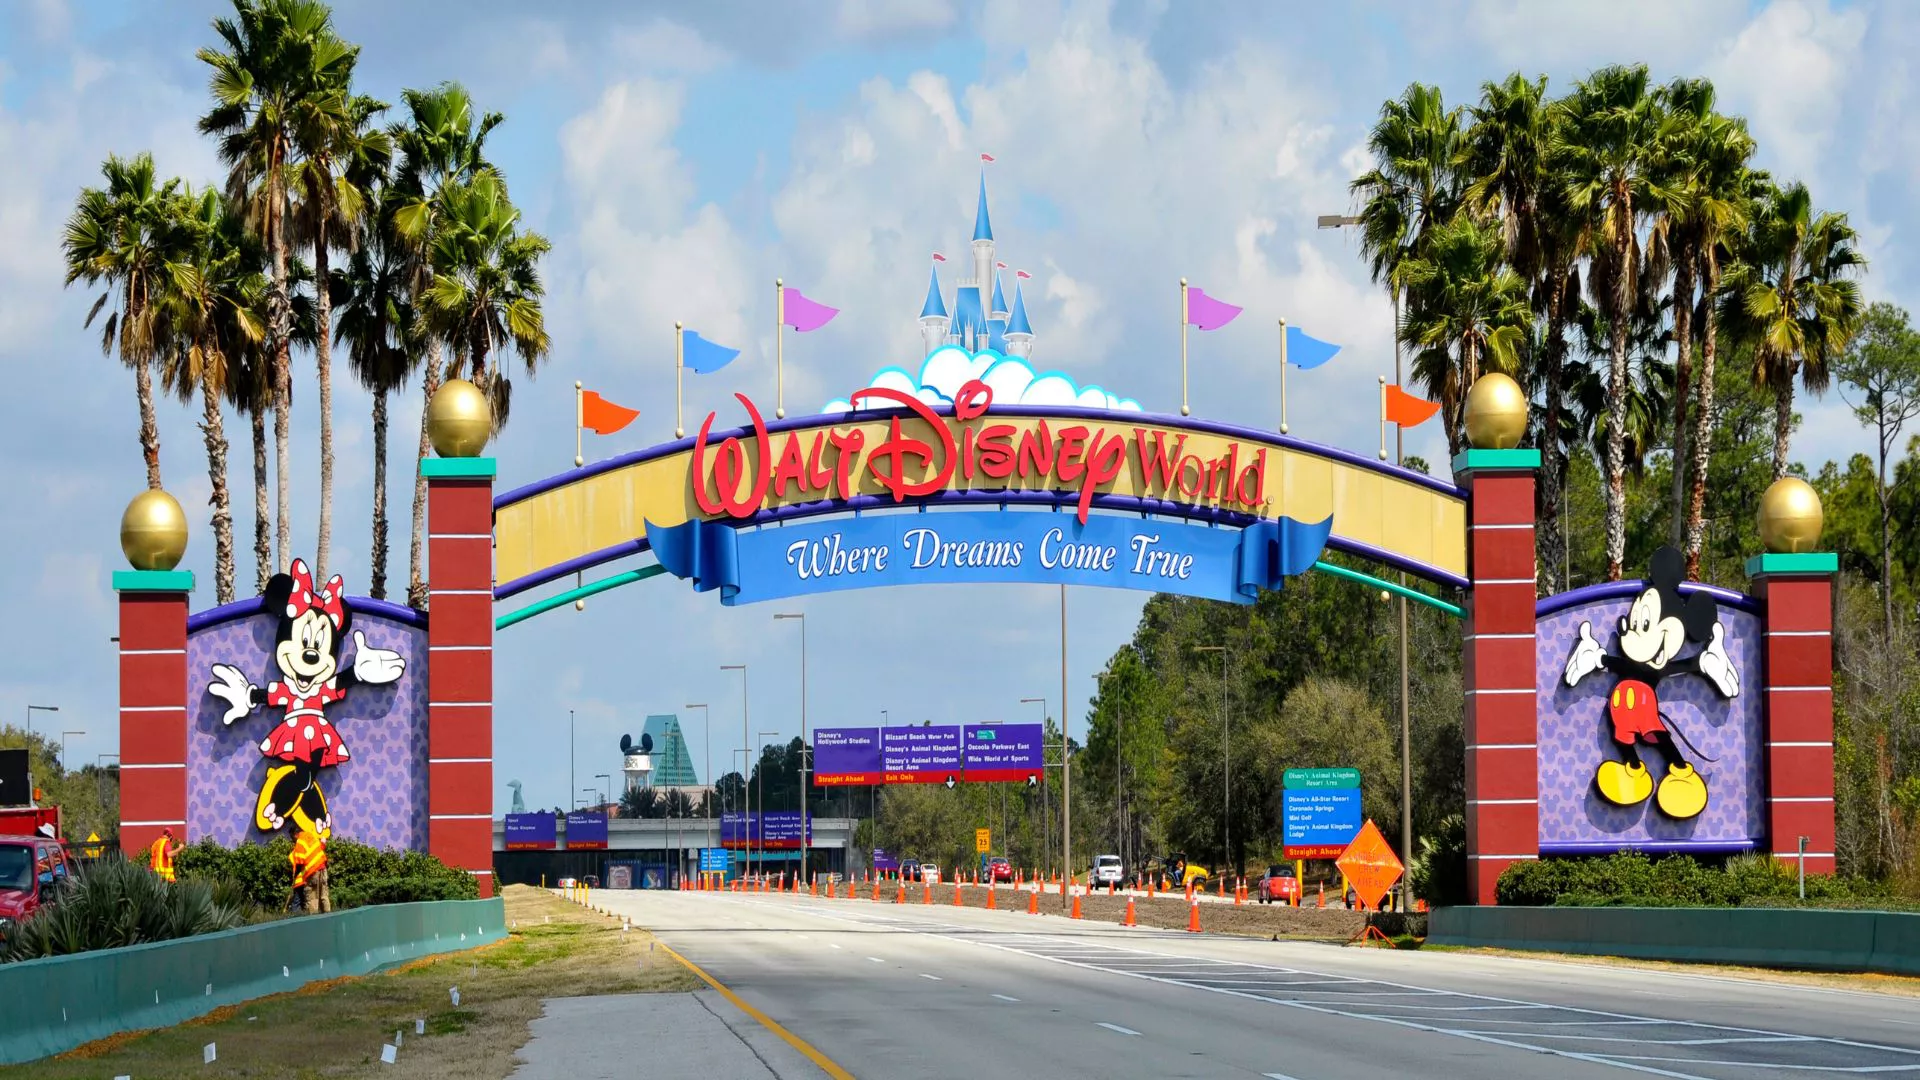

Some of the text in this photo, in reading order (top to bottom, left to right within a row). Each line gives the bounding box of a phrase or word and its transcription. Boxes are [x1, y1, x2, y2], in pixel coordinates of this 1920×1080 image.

[786, 527, 1194, 580] Where Dreams Come True
[885, 745, 909, 753] Disney's
[992, 743, 1015, 751] Parkway
[1011, 755, 1029, 763] Sports
[900, 774, 914, 782] Only
[1288, 772, 1309, 780] Disney's
[1332, 772, 1356, 780] Kingdom
[1315, 805, 1335, 813] Springs
[1330, 823, 1354, 831] Kingdom
[1289, 847, 1342, 857] Straight Ahead
